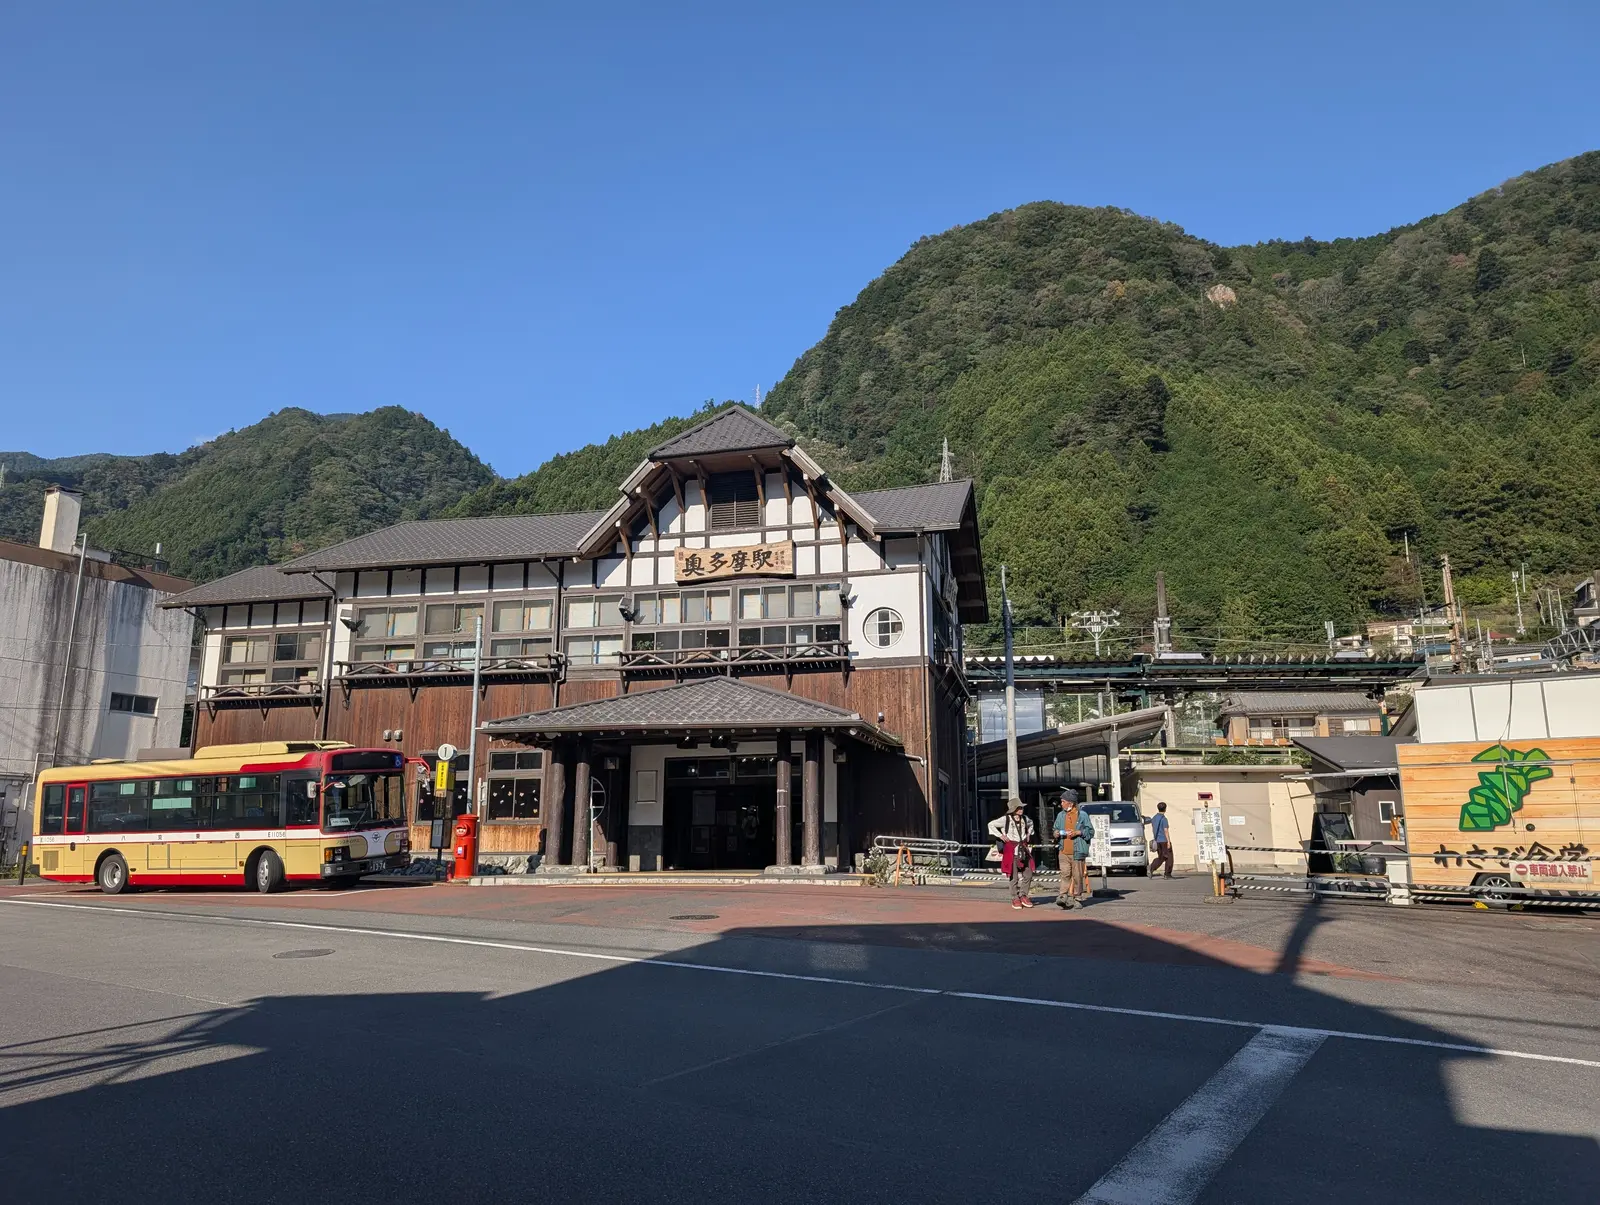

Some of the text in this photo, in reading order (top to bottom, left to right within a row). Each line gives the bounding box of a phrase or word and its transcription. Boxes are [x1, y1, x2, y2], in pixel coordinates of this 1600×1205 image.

[682, 549, 774, 577] 奥多摩駅
[1201, 811, 1219, 861] 駐車禁止
[1529, 863, 1589, 878] 車両進入禁止
